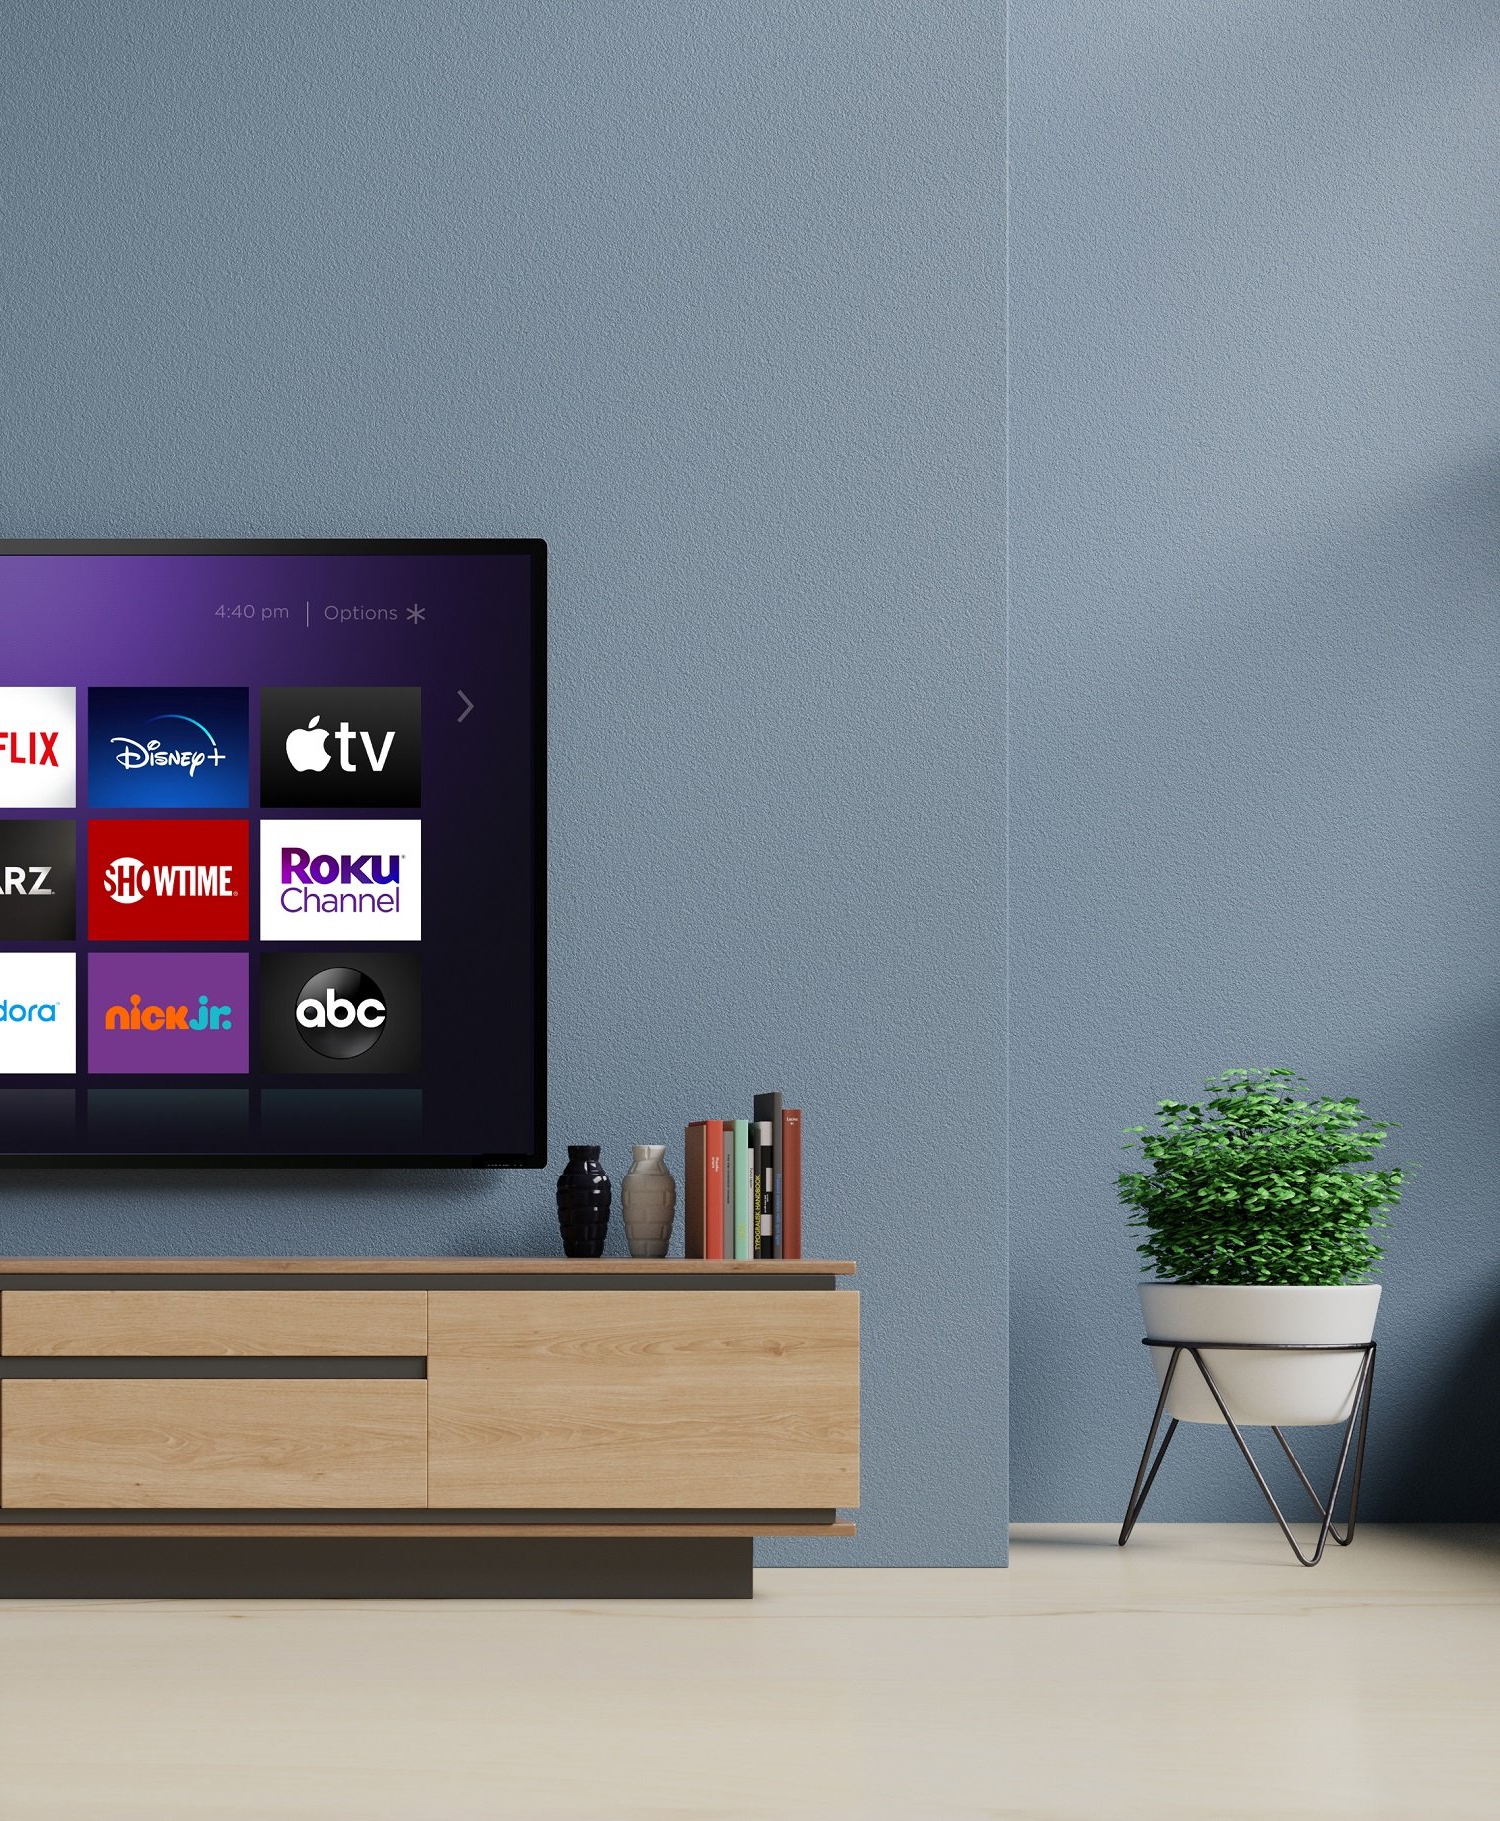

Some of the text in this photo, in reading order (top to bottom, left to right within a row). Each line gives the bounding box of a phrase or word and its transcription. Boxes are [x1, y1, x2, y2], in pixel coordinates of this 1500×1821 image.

[215, 605, 289, 621] 4:40 pm
[324, 605, 398, 622] Options
[334, 721, 396, 772] tv
[103, 857, 233, 904] SHOWTIME
[280, 886, 400, 913] Channel
[296, 988, 386, 1028] abc
